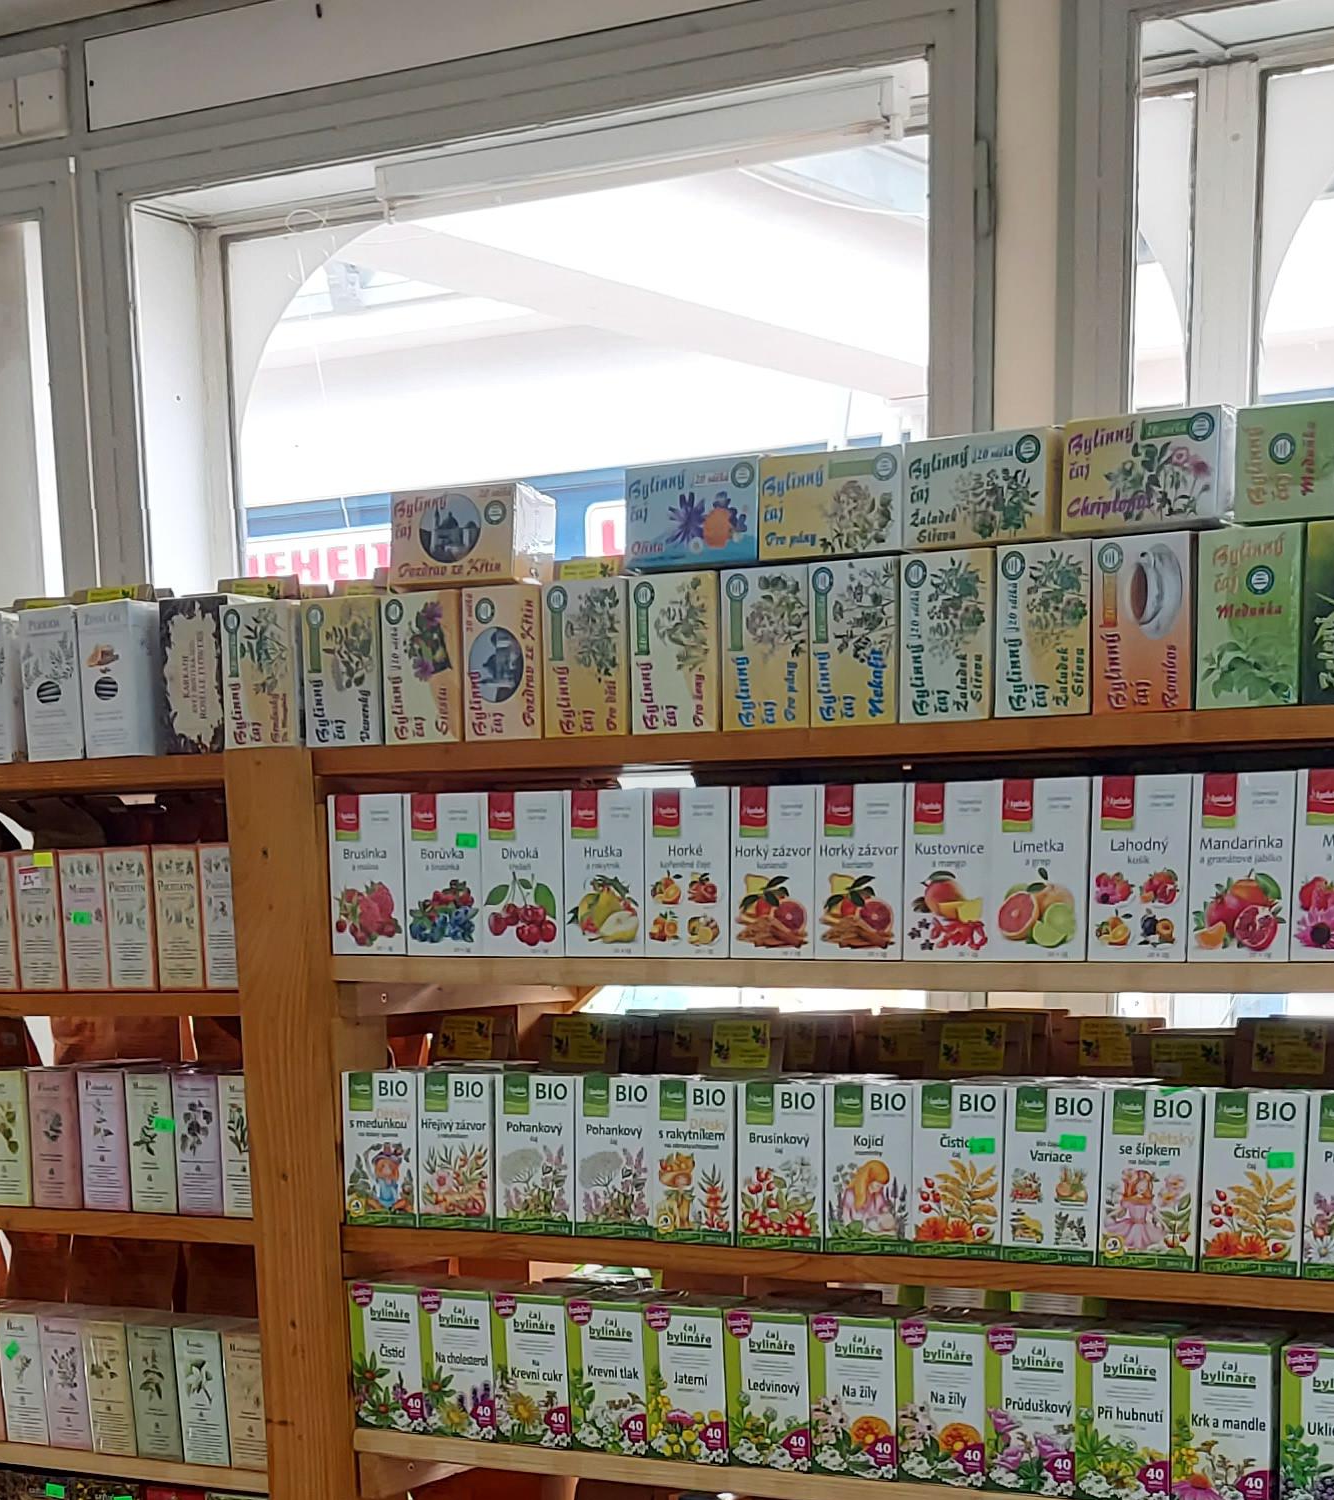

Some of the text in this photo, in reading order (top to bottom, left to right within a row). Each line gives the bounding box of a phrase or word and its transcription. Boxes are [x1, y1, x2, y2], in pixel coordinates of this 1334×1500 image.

[1068, 421, 1135, 458] Bylinný
[909, 448, 970, 481] Bylinný
[1069, 460, 1090, 482] čaj
[911, 483, 929, 505] čaj
[395, 522, 412, 541] čaj
[915, 842, 984, 855] Kustovnice
[1013, 840, 1064, 853] Limetka
[1110, 838, 1168, 855] Lahodný
[1200, 834, 1282, 850] Mandarinka
[343, 847, 387, 860] Brusinka
[501, 846, 538, 860] Divoká
[584, 845, 622, 858] Hruška
[668, 843, 702, 857] Horké
[735, 843, 811, 858] Horký zázvor
[378, 1080, 407, 1097] BIO
[1055, 1097, 1092, 1115] BIO
[1153, 1100, 1192, 1117] BIO
[356, 1118, 407, 1129] meduňkou
[455, 1120, 486, 1131] zázvor
[507, 1121, 562, 1135] Pohankový
[666, 1129, 725, 1141] rakytníkem
[749, 1133, 810, 1147] Brusinkový
[853, 1134, 884, 1148] Kojící
[1030, 1150, 1072, 1163] Variace
[1119, 1143, 1180, 1158] se šípkem
[620, 1366, 638, 1380] tlak
[842, 1385, 877, 1401] Na žíly
[1006, 1397, 1072, 1417] Průduškový
[1098, 1407, 1164, 1423] Při hubnutí
[1192, 1414, 1210, 1428] Krk
[1222, 1417, 1266, 1431] mandle
